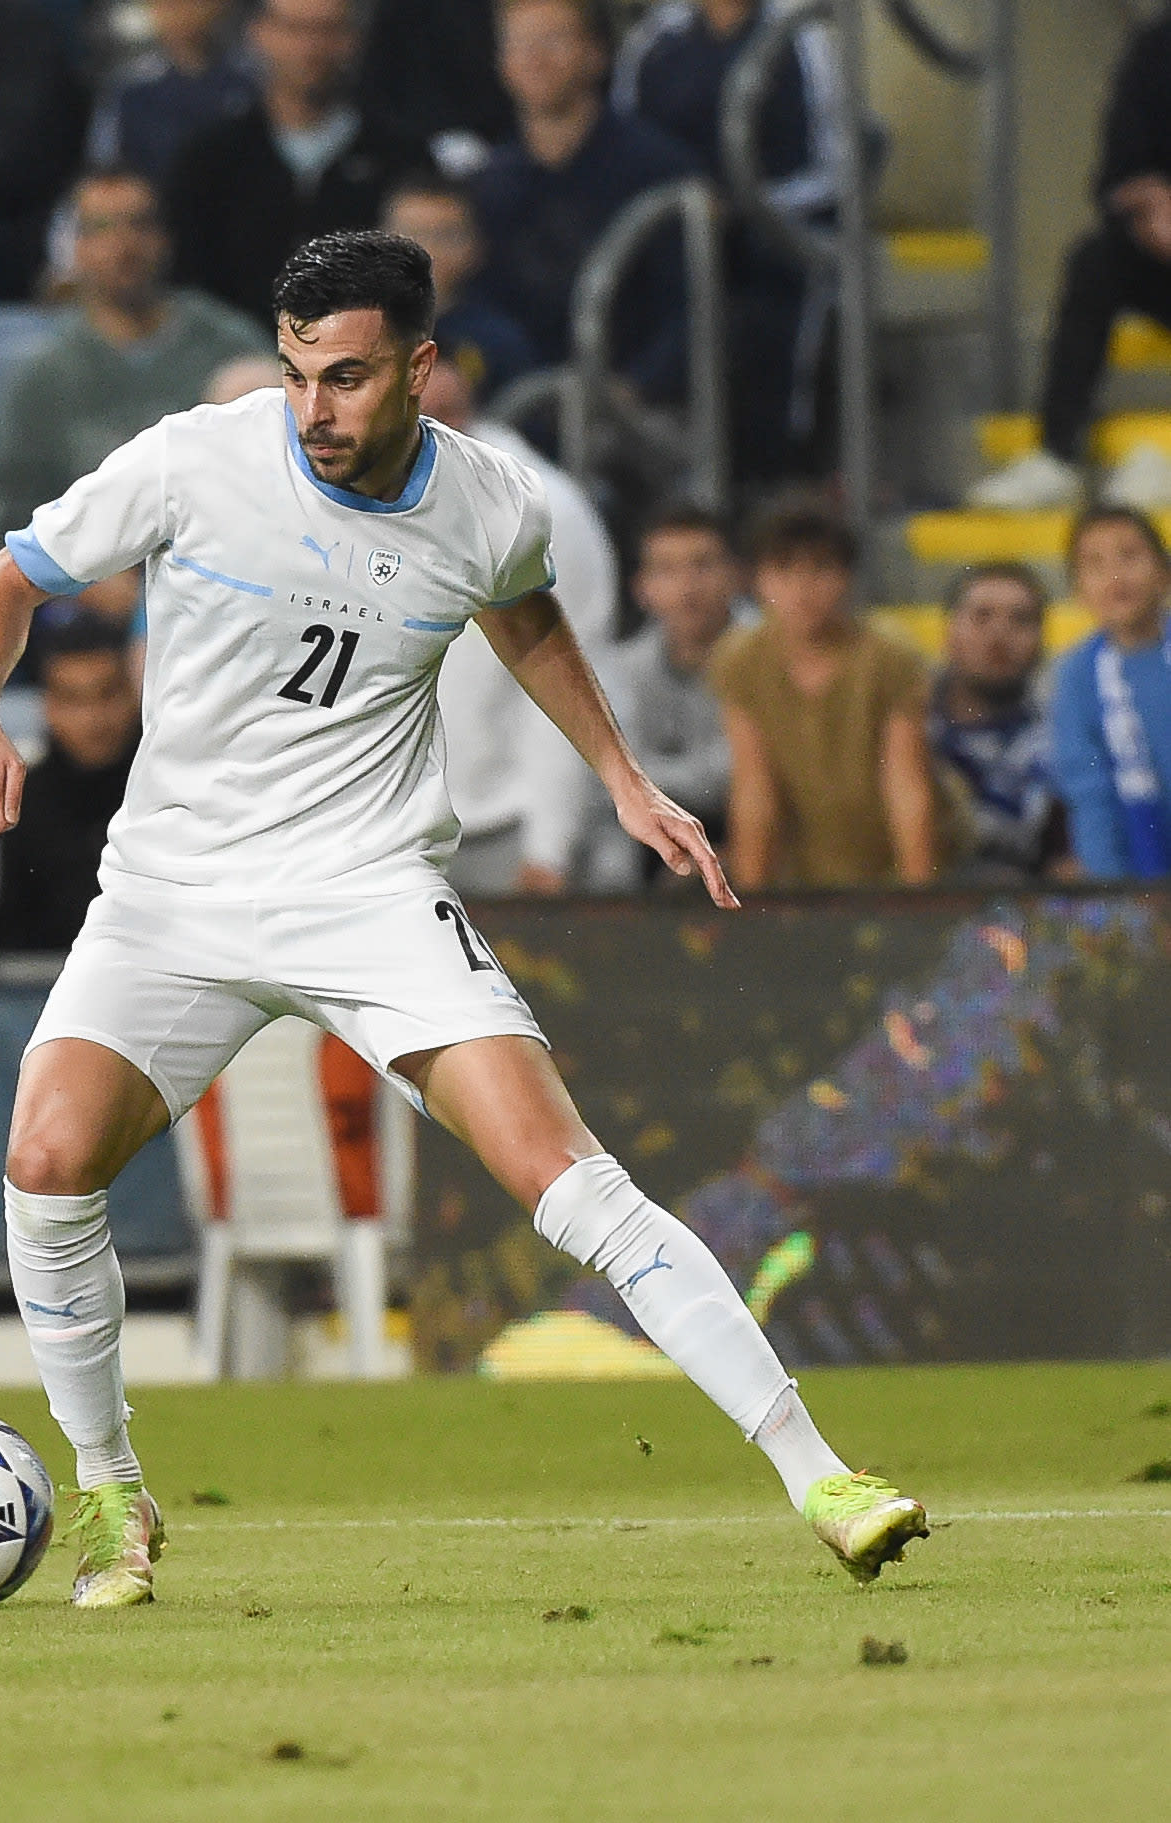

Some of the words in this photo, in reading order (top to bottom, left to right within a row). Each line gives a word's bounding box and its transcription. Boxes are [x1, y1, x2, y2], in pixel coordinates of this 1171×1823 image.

[375, 551, 396, 561] ISRAEL
[289, 592, 385, 623] ISRAEL
[276, 623, 361, 709] 21
